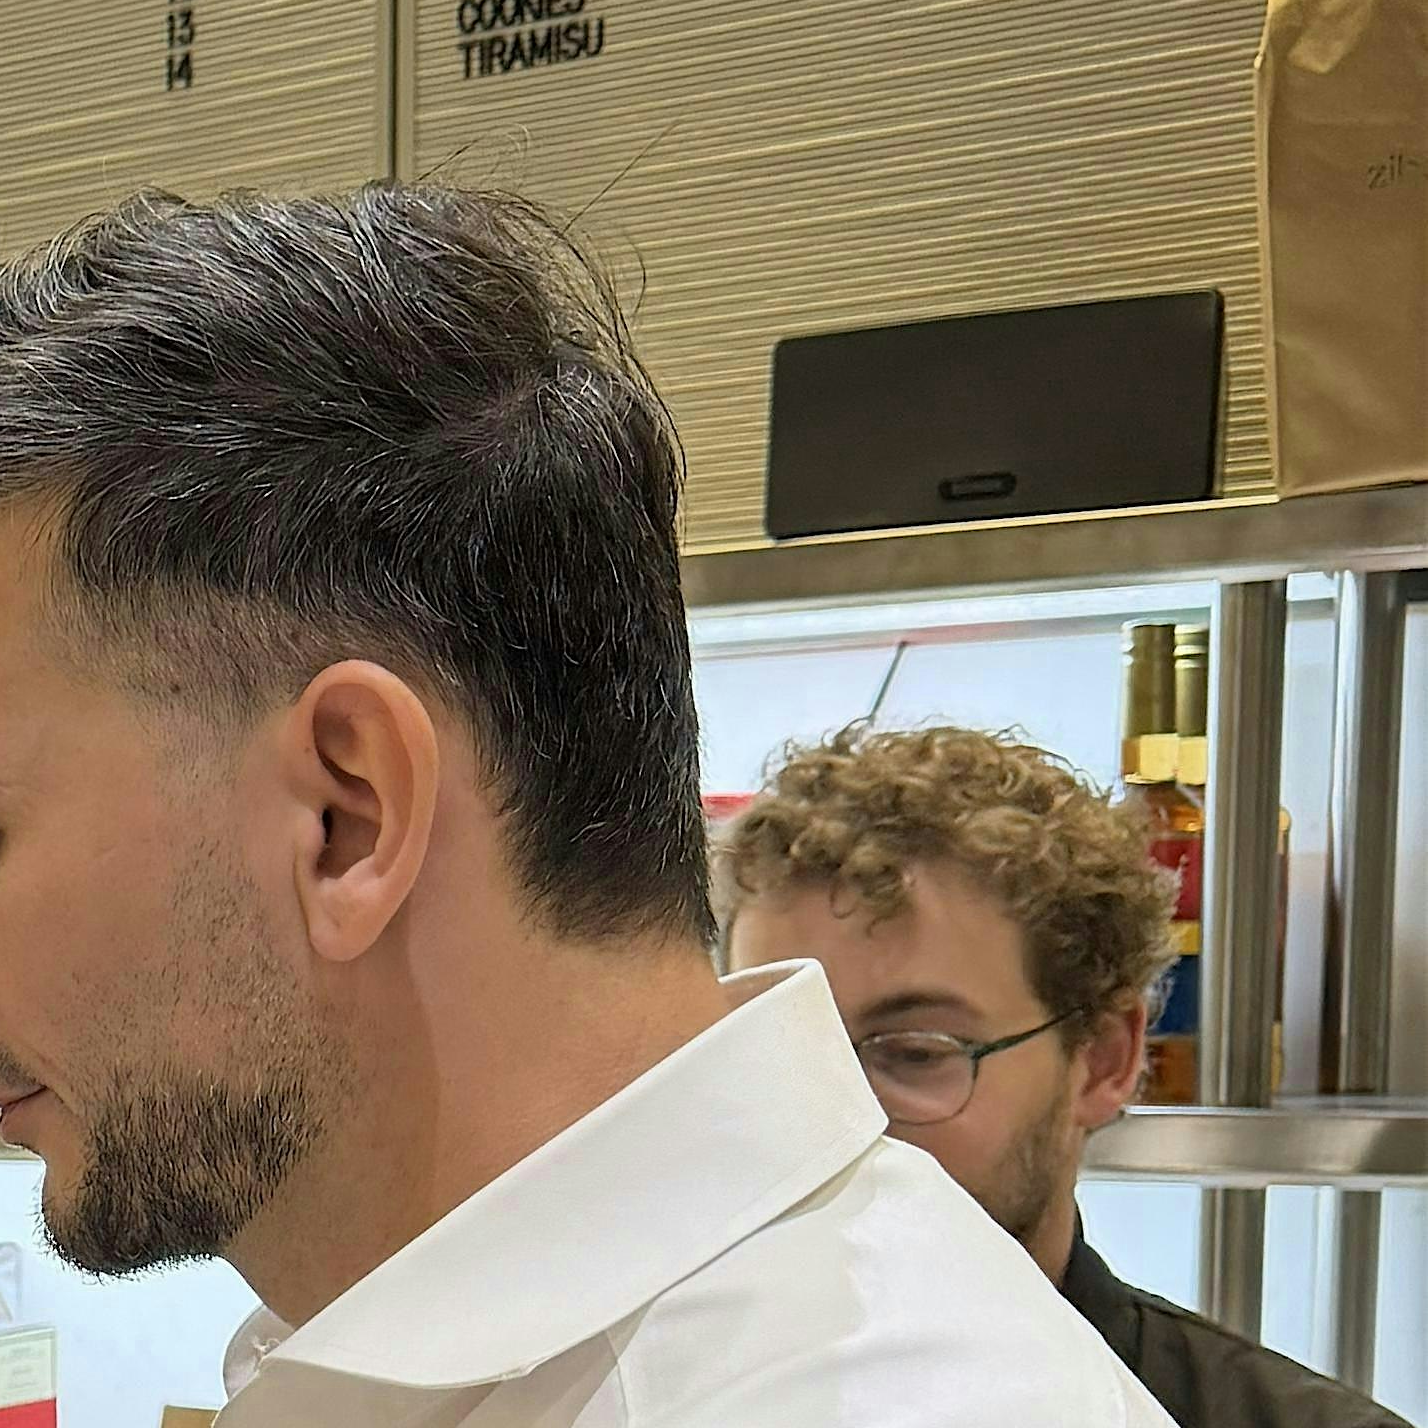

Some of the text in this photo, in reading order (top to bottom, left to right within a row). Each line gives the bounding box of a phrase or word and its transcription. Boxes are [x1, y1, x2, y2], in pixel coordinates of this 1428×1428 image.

[166, 10, 193, 48] 13
[459, 19, 604, 79] TIRAMISU
[166, 52, 193, 92] 14
